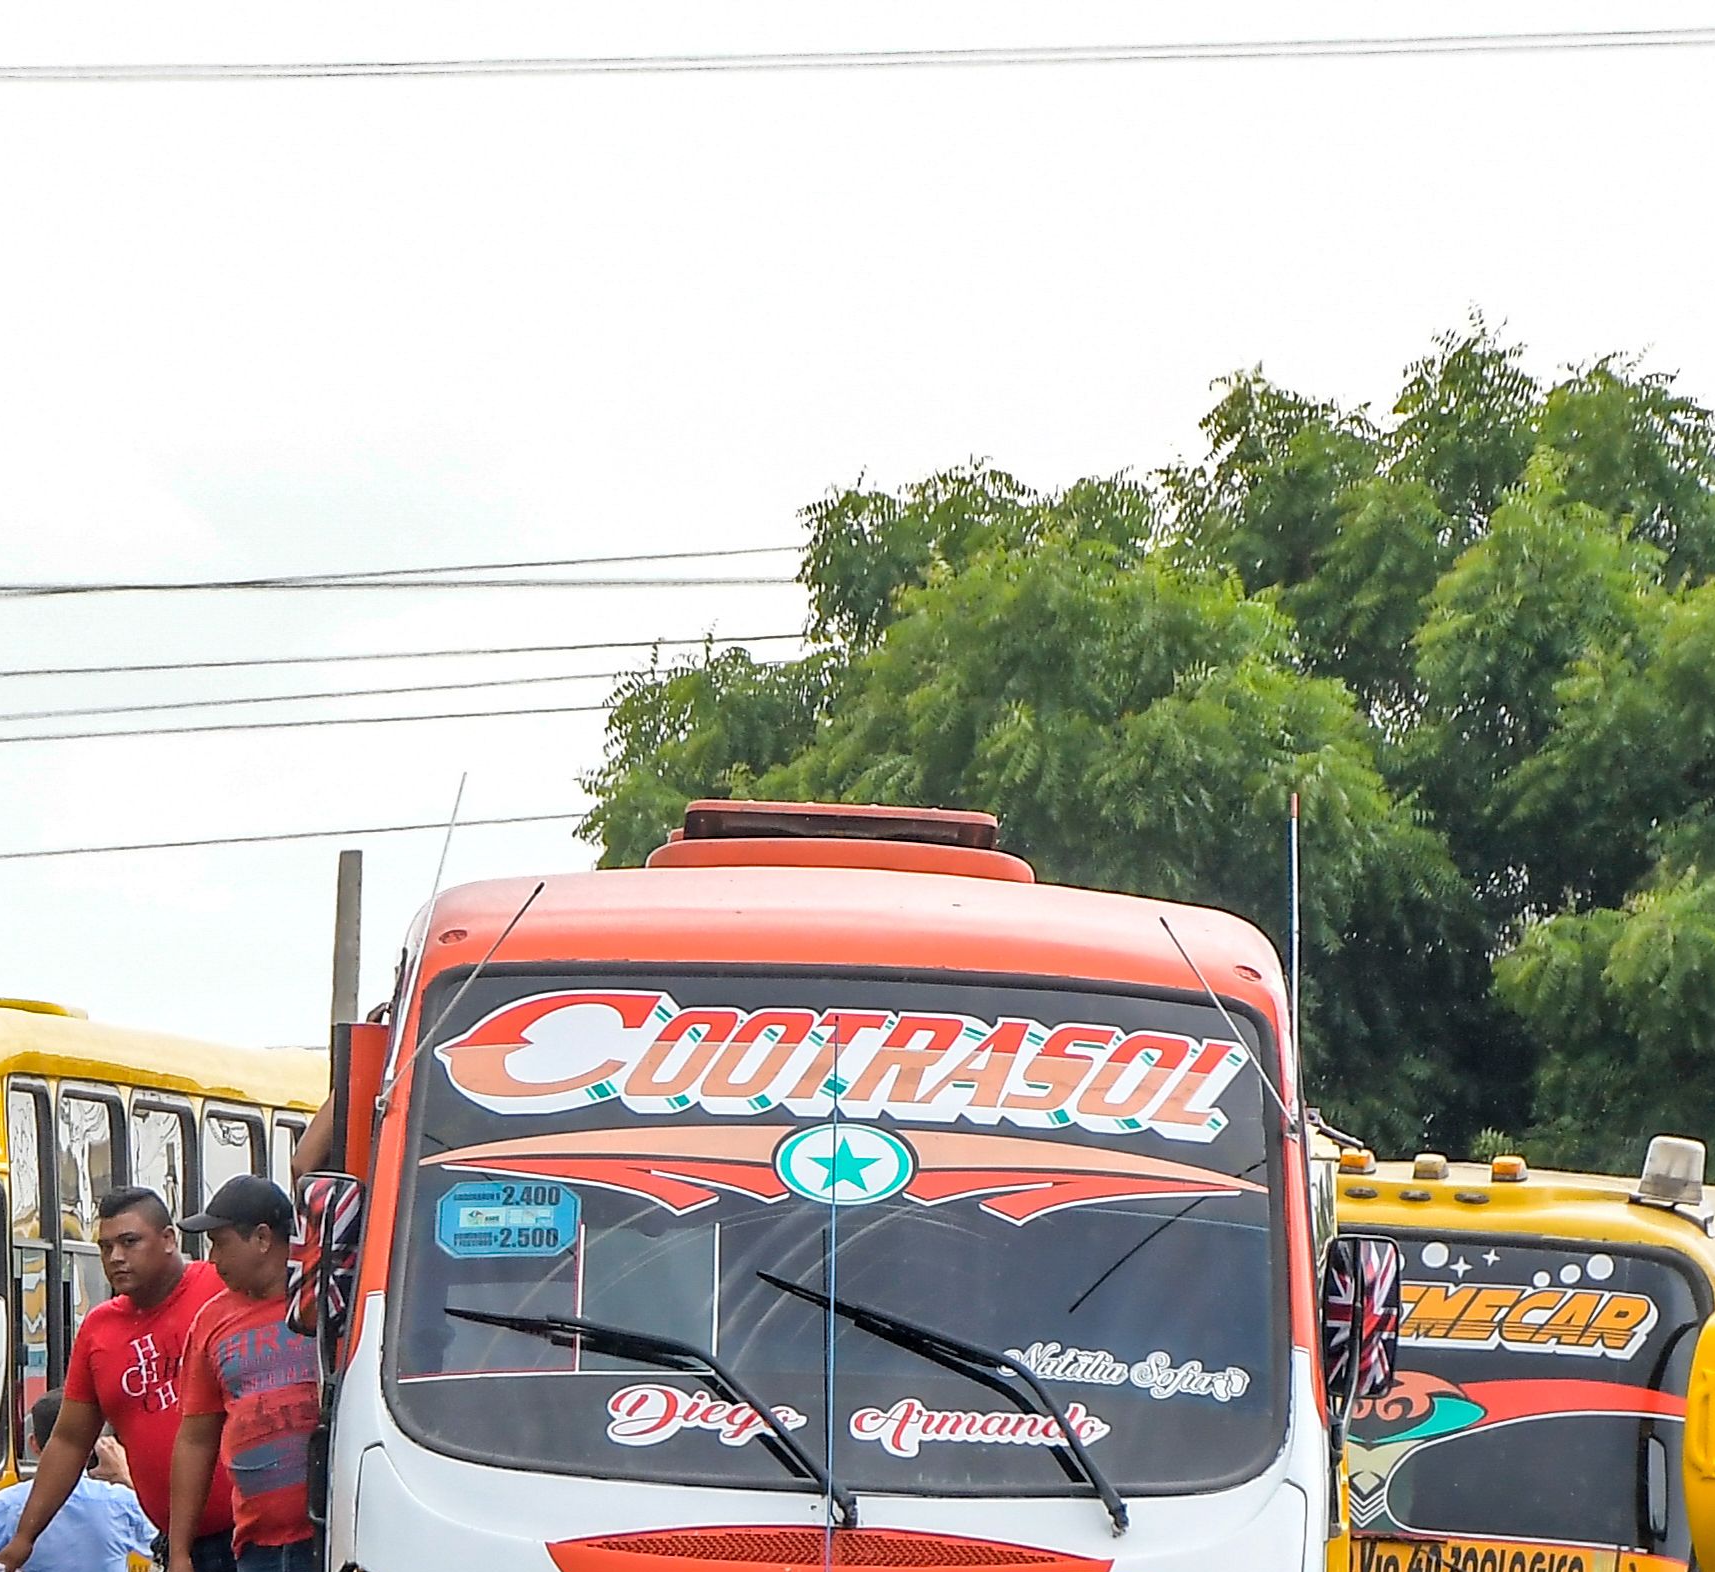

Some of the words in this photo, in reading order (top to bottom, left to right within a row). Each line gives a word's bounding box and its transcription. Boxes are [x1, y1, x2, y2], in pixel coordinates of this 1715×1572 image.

[436, 991, 1244, 1138] COOTRASOL
[502, 1185, 561, 1206] 2.400
[499, 1227, 559, 1248] 2.500
[607, 1384, 808, 1447] Diego
[849, 1398, 1111, 1458] Armando
